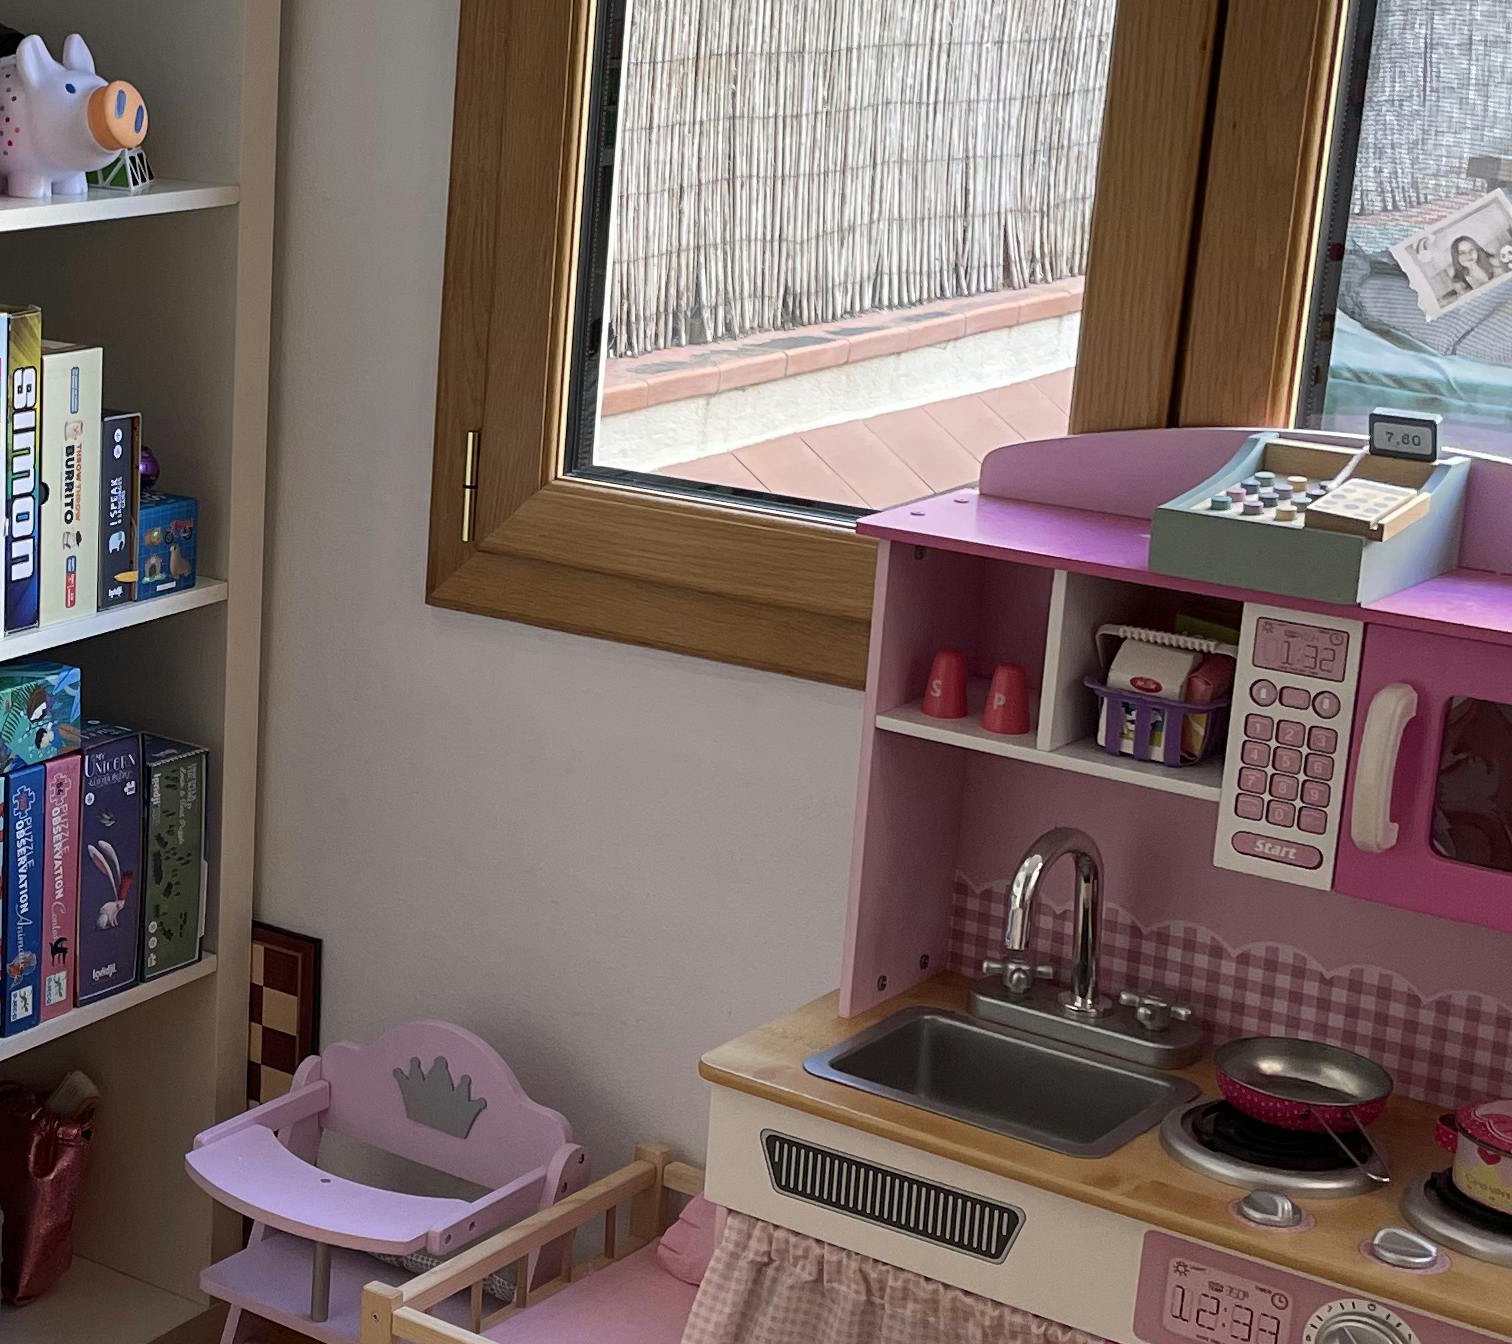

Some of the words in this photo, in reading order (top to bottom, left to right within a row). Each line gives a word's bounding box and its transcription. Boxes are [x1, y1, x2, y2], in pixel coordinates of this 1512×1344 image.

[64, 444, 75, 525] BURRITO
[15, 819, 29, 915] OBSERVATION
[51, 806, 65, 901] OBSERVATION
[1253, 838, 1297, 861] Start
